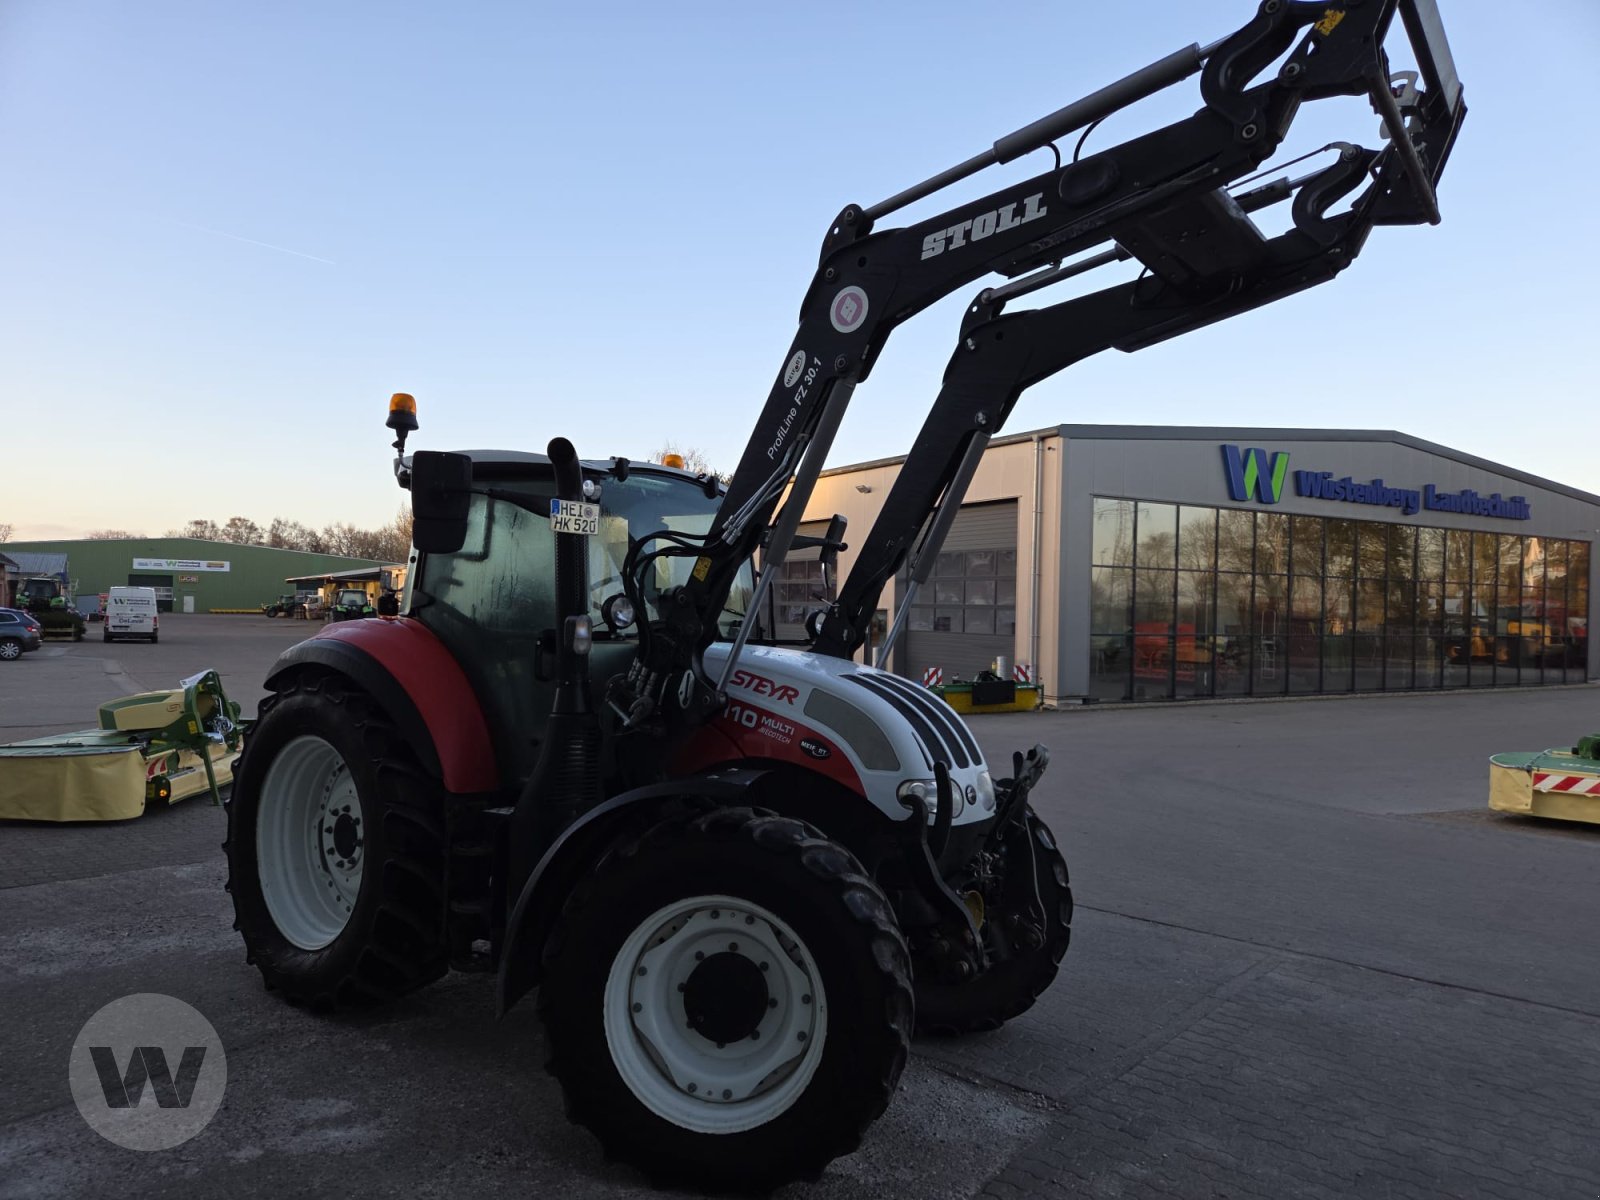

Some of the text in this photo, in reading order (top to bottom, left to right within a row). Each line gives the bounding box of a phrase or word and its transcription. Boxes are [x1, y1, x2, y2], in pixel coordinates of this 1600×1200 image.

[920, 192, 1048, 261] STOLL
[767, 356, 822, 460] ProfiLine FZ 30.1
[1220, 444, 1290, 505] W
[1295, 470, 1532, 521] Wüstenberg Landtechnik
[554, 517, 596, 533] HK 520
[561, 503, 583, 518] HEI
[729, 670, 799, 705] STEYR
[761, 715, 795, 736] MULTI
